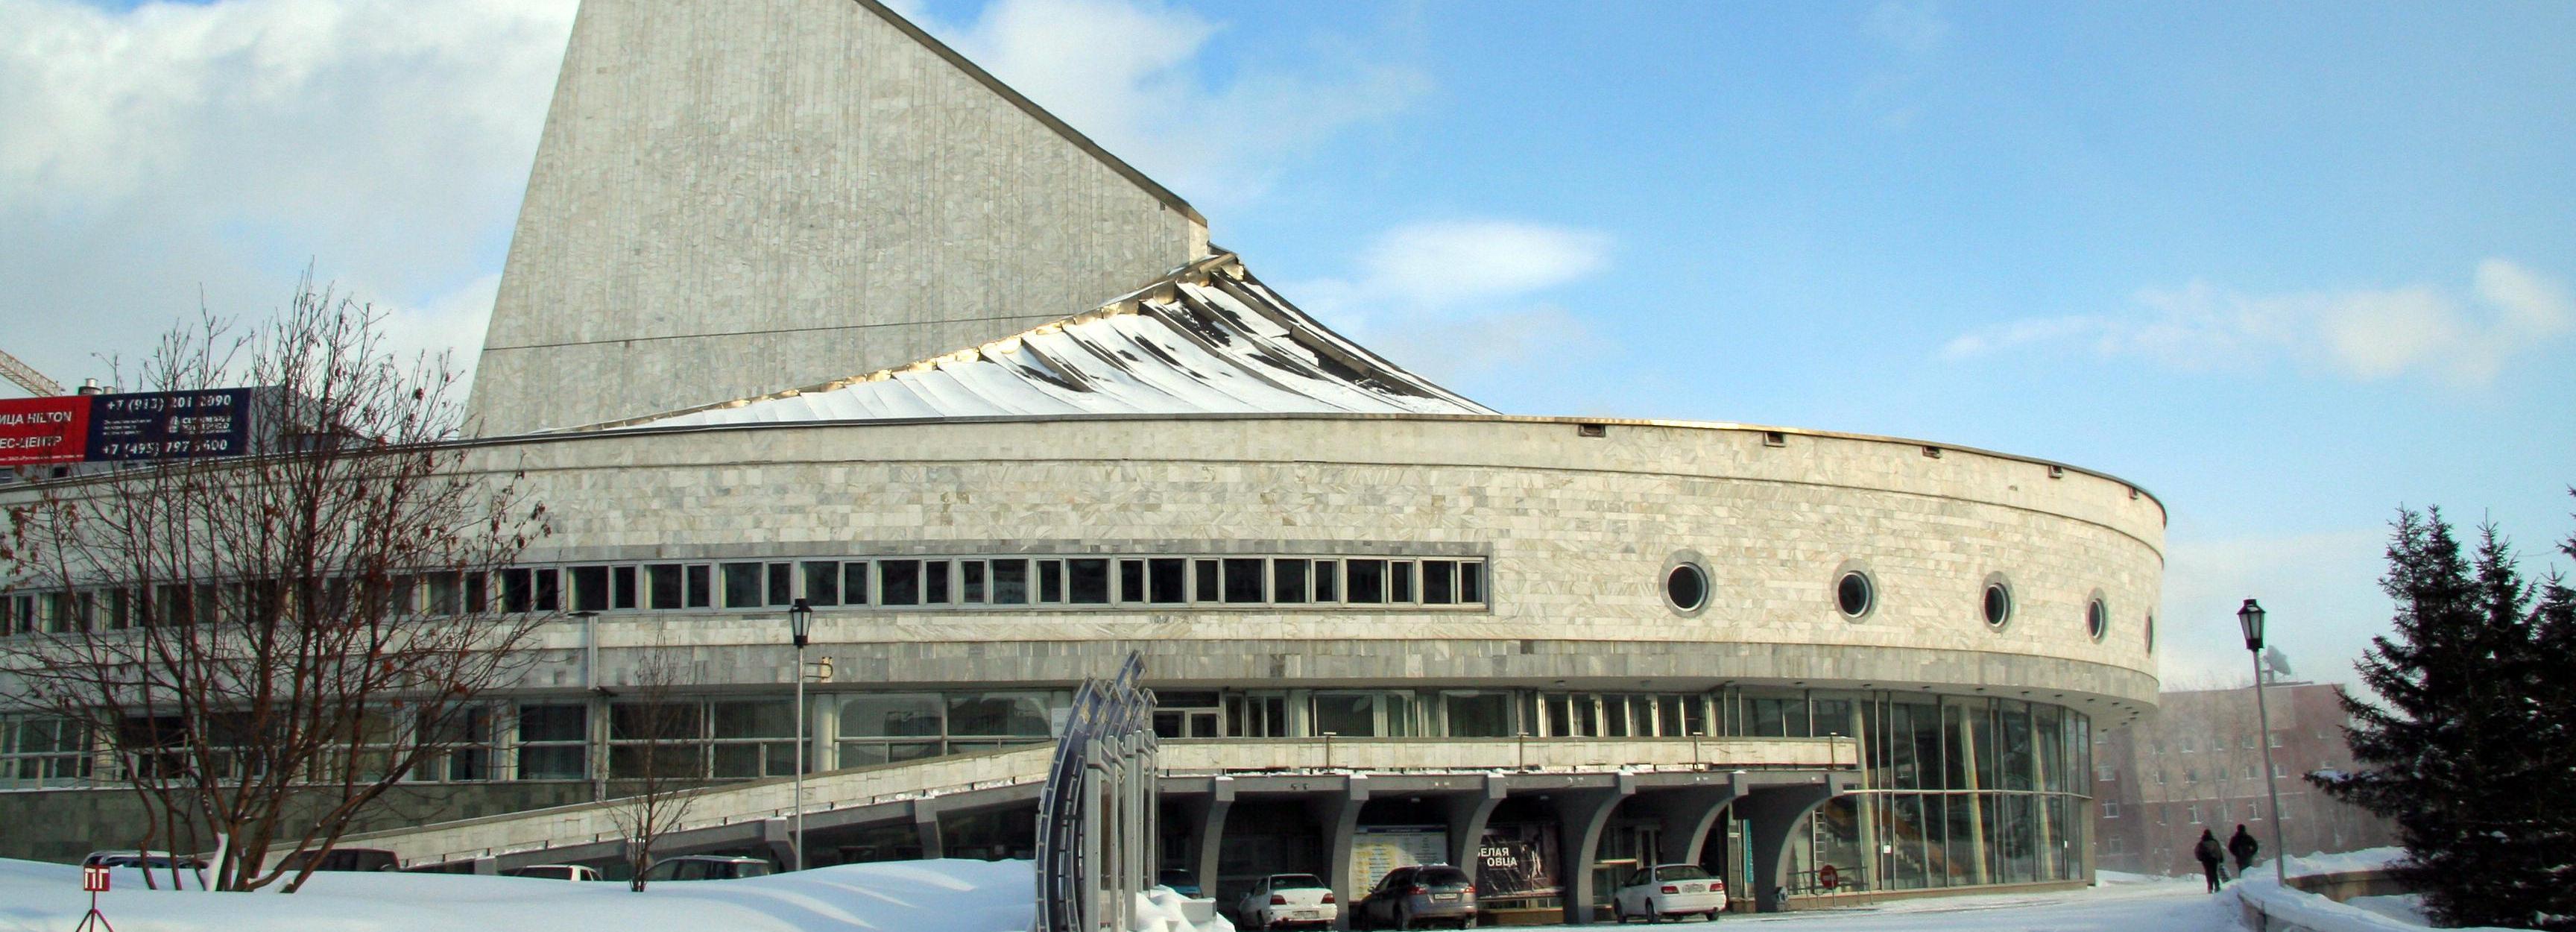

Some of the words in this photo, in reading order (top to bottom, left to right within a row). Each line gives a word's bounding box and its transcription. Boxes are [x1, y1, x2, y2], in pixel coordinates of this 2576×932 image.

[107, 400, 124, 410] +7
[28, 412, 72, 424] HILTON
[1477, 847, 1509, 857] ЕЛАЯ
[1487, 857, 1518, 867] ОВЦА
[85, 868, 109, 889] ПГ
